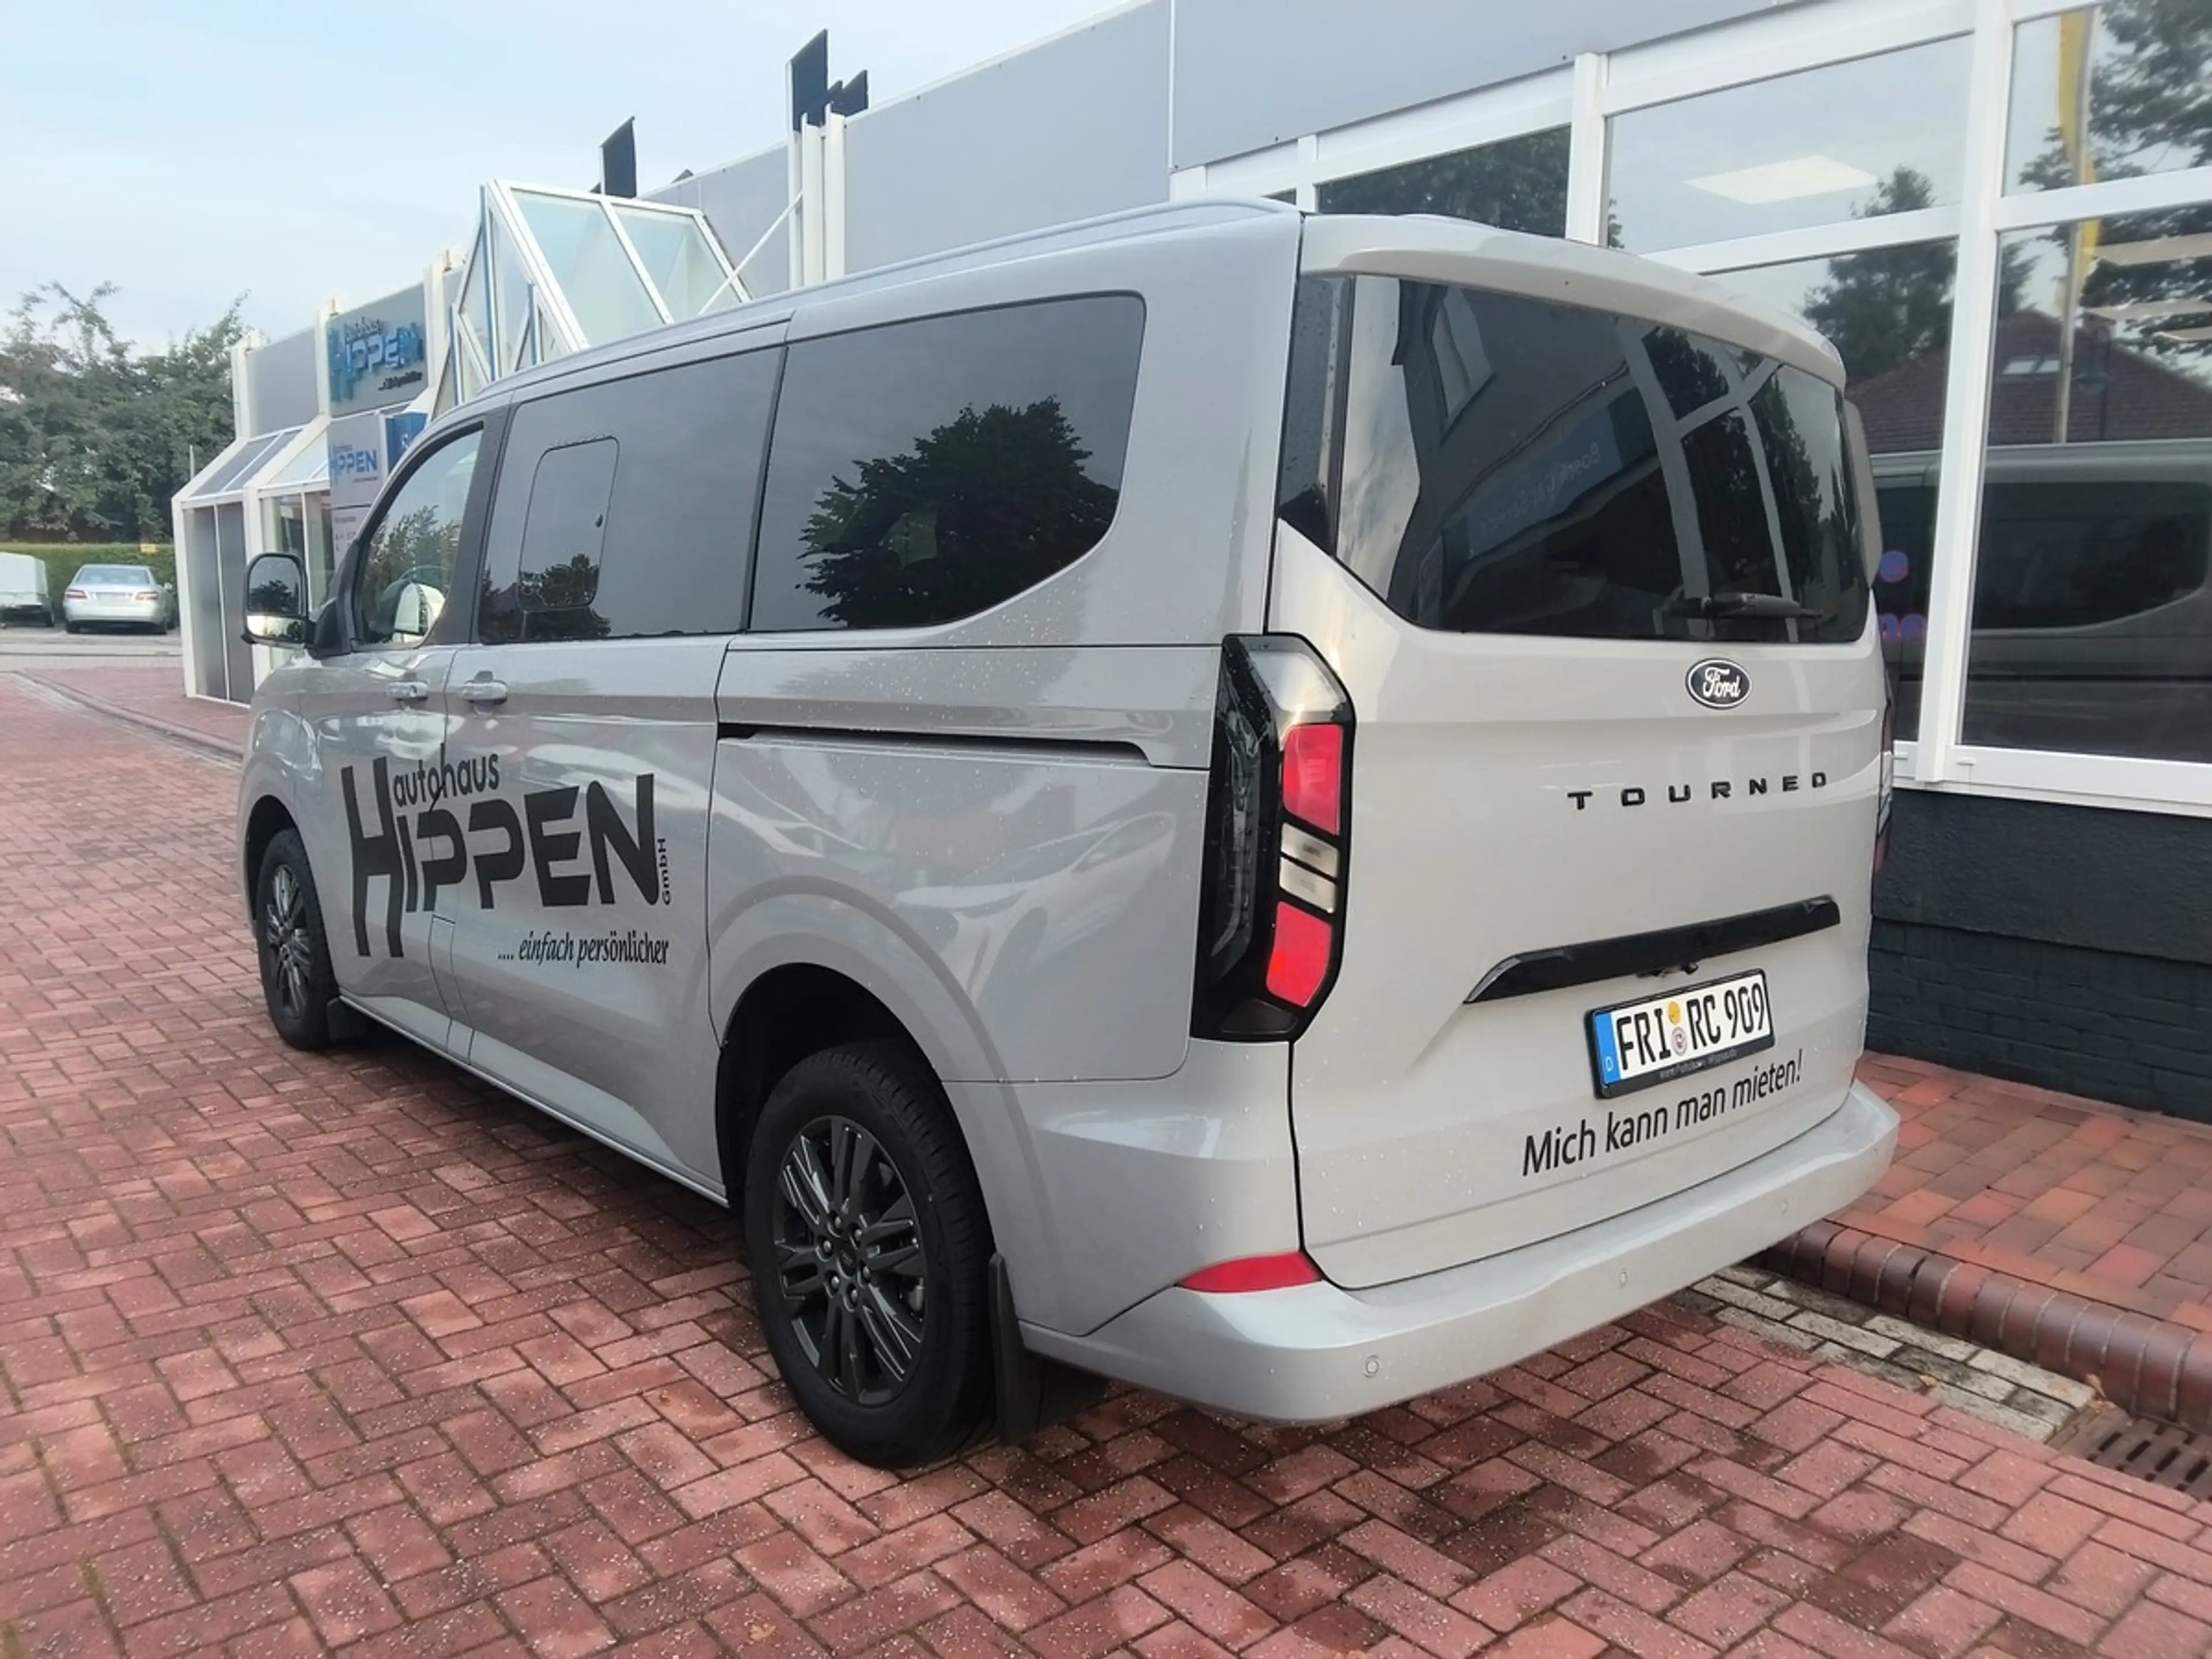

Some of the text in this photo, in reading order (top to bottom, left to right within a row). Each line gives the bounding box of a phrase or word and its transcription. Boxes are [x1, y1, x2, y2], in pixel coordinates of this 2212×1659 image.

[1702, 666, 1741, 698] Ford
[393, 743, 499, 807] autohaus
[341, 756, 659, 958] HIPPEN
[657, 838, 671, 906] GmbH
[518, 931, 574, 966] einfach
[576, 931, 669, 969] persönlicher
[1615, 1007, 1671, 1070] FRI
[1687, 996, 1721, 1050] RC
[1724, 982, 1765, 1040] 909
[1522, 1120, 1596, 1177] Mich
[1605, 1111, 1668, 1153] kann
[1675, 1087, 1726, 1130] man
[1732, 1049, 1803, 1109] mieten!
